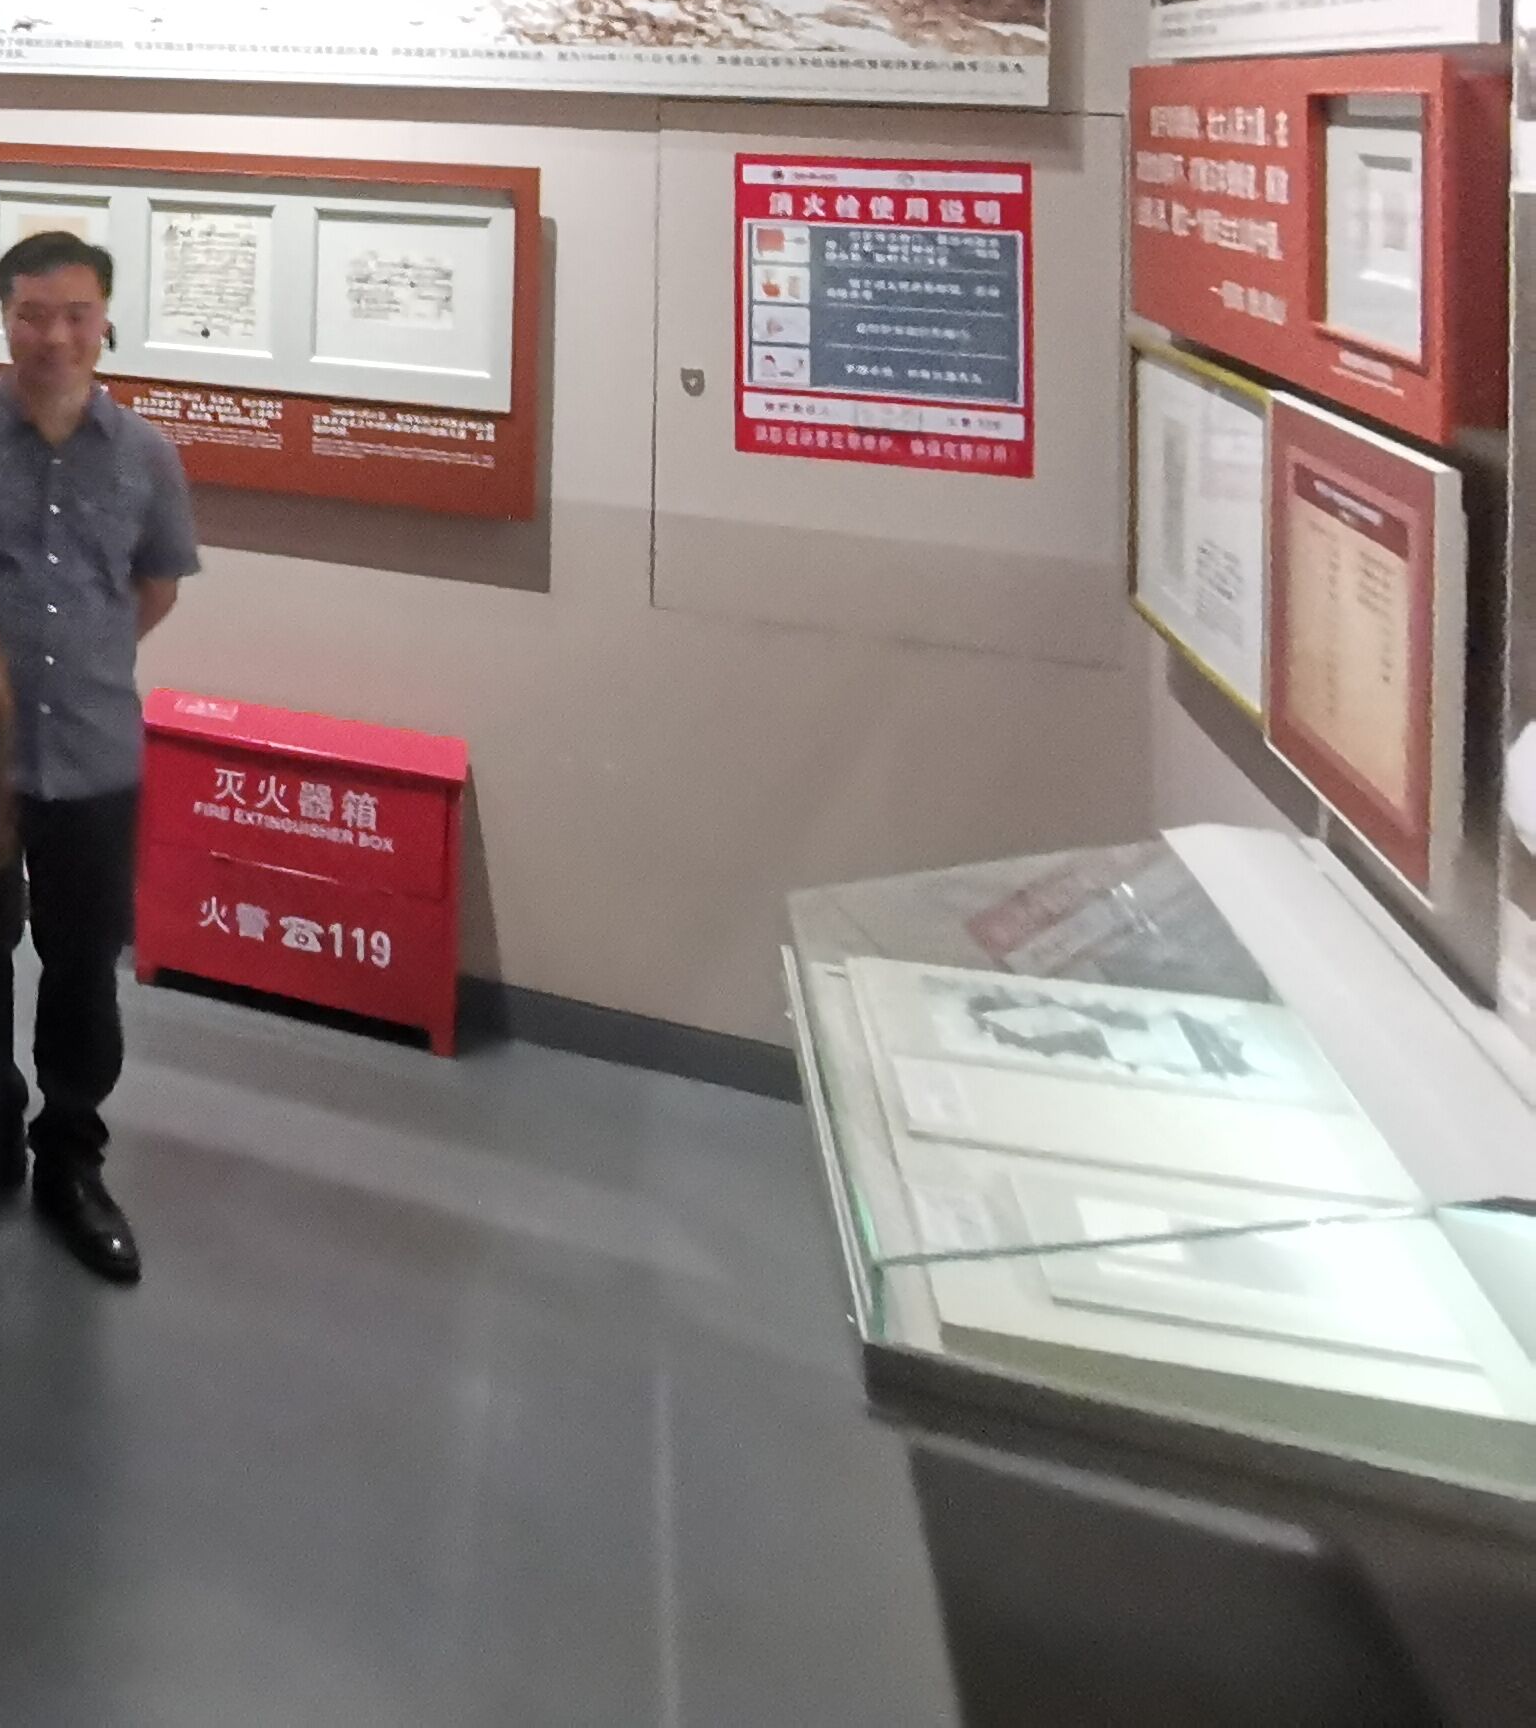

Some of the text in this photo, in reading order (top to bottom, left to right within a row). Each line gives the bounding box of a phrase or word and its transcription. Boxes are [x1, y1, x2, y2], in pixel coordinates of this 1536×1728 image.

[193, 800, 231, 821] FIRE
[358, 831, 395, 854] BOX
[214, 768, 378, 832] 灭火器箱
[328, 922, 393, 969] 119
